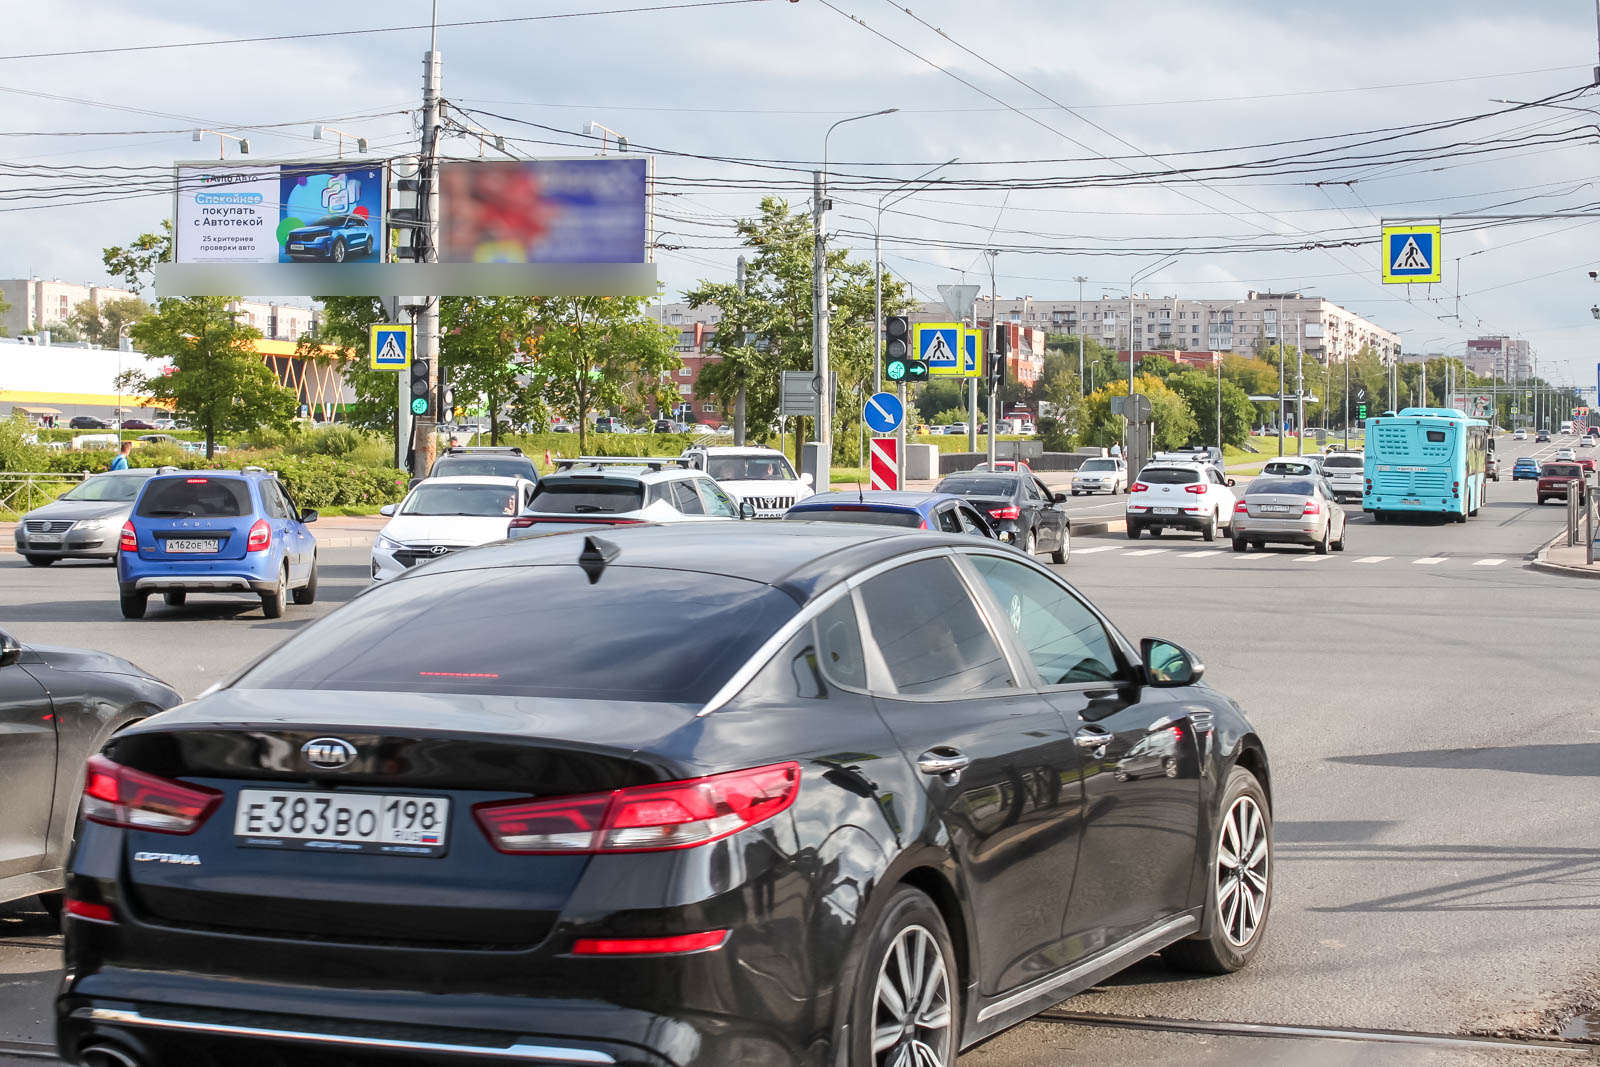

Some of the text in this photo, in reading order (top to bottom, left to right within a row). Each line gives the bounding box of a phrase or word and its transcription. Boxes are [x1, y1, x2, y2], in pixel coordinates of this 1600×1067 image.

[197, 192, 261, 204] Спокойнее
[202, 207, 256, 217] покупать
[194, 216, 263, 227] с Автотекой
[307, 744, 347, 763] KIA
[386, 799, 437, 830] 198
[133, 851, 202, 865] OPTIMA
